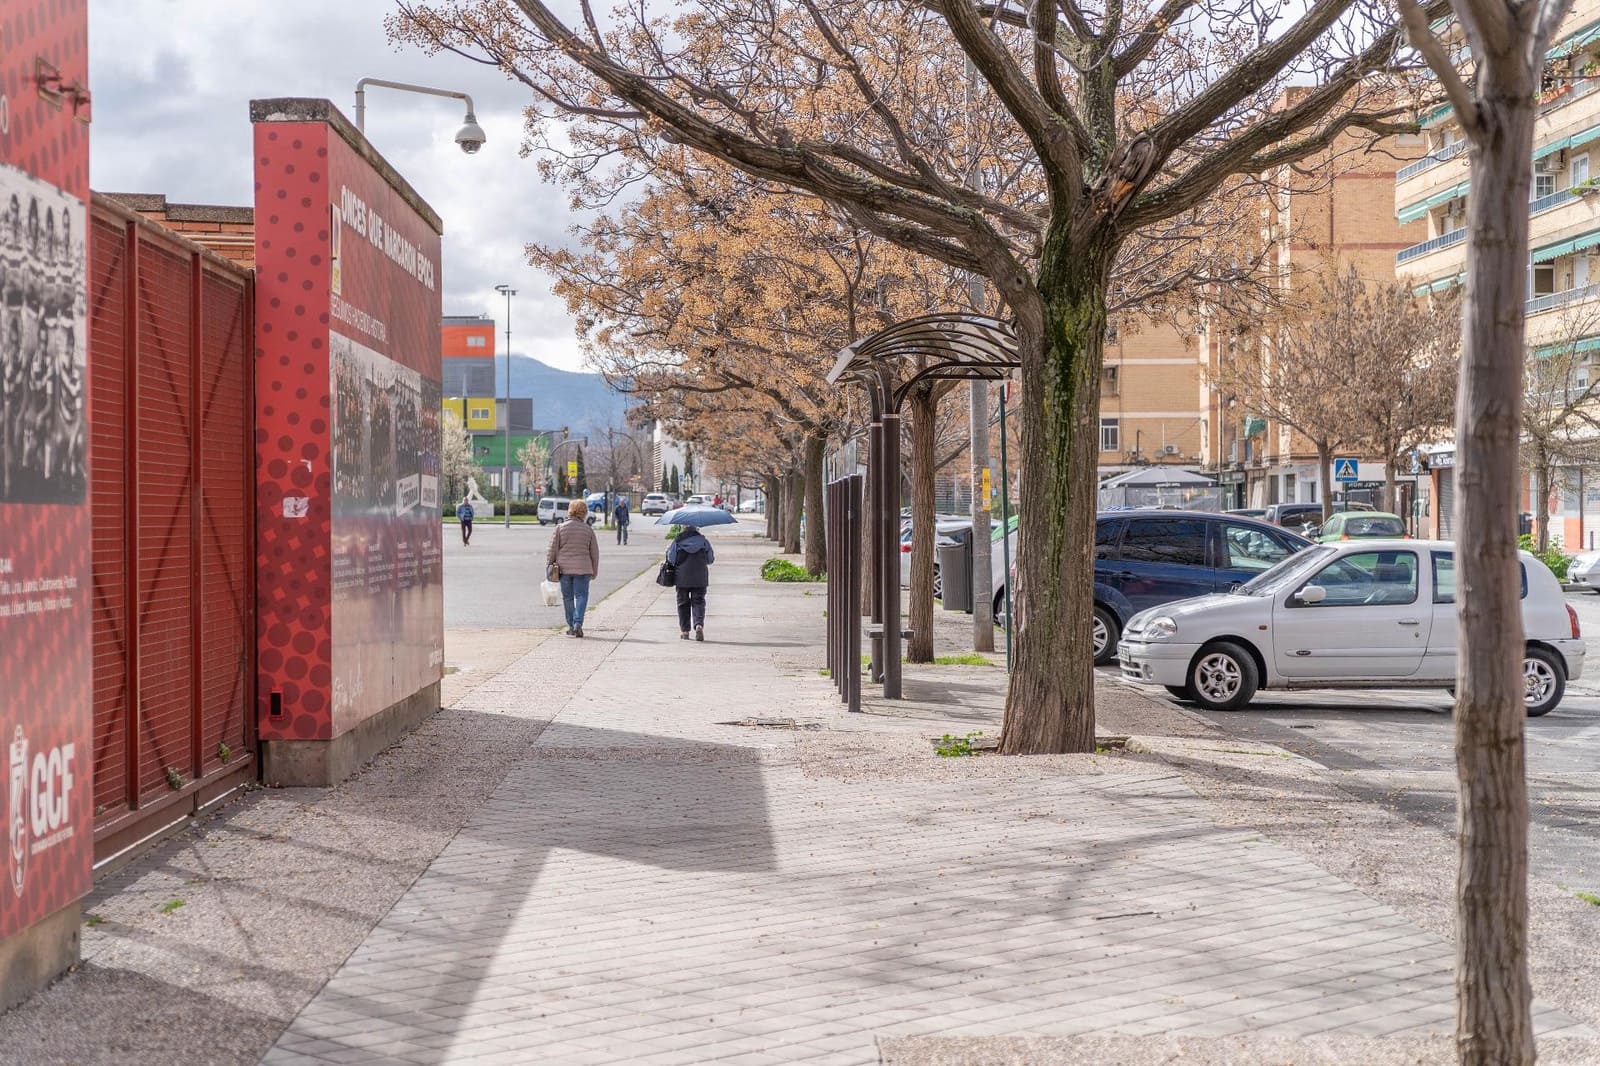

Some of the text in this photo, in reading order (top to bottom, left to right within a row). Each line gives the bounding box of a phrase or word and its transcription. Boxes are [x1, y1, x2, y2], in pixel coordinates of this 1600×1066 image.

[341, 184, 435, 292] ONCES QUE MARCARON ÉPOCA
[31, 742, 75, 838] GCF
